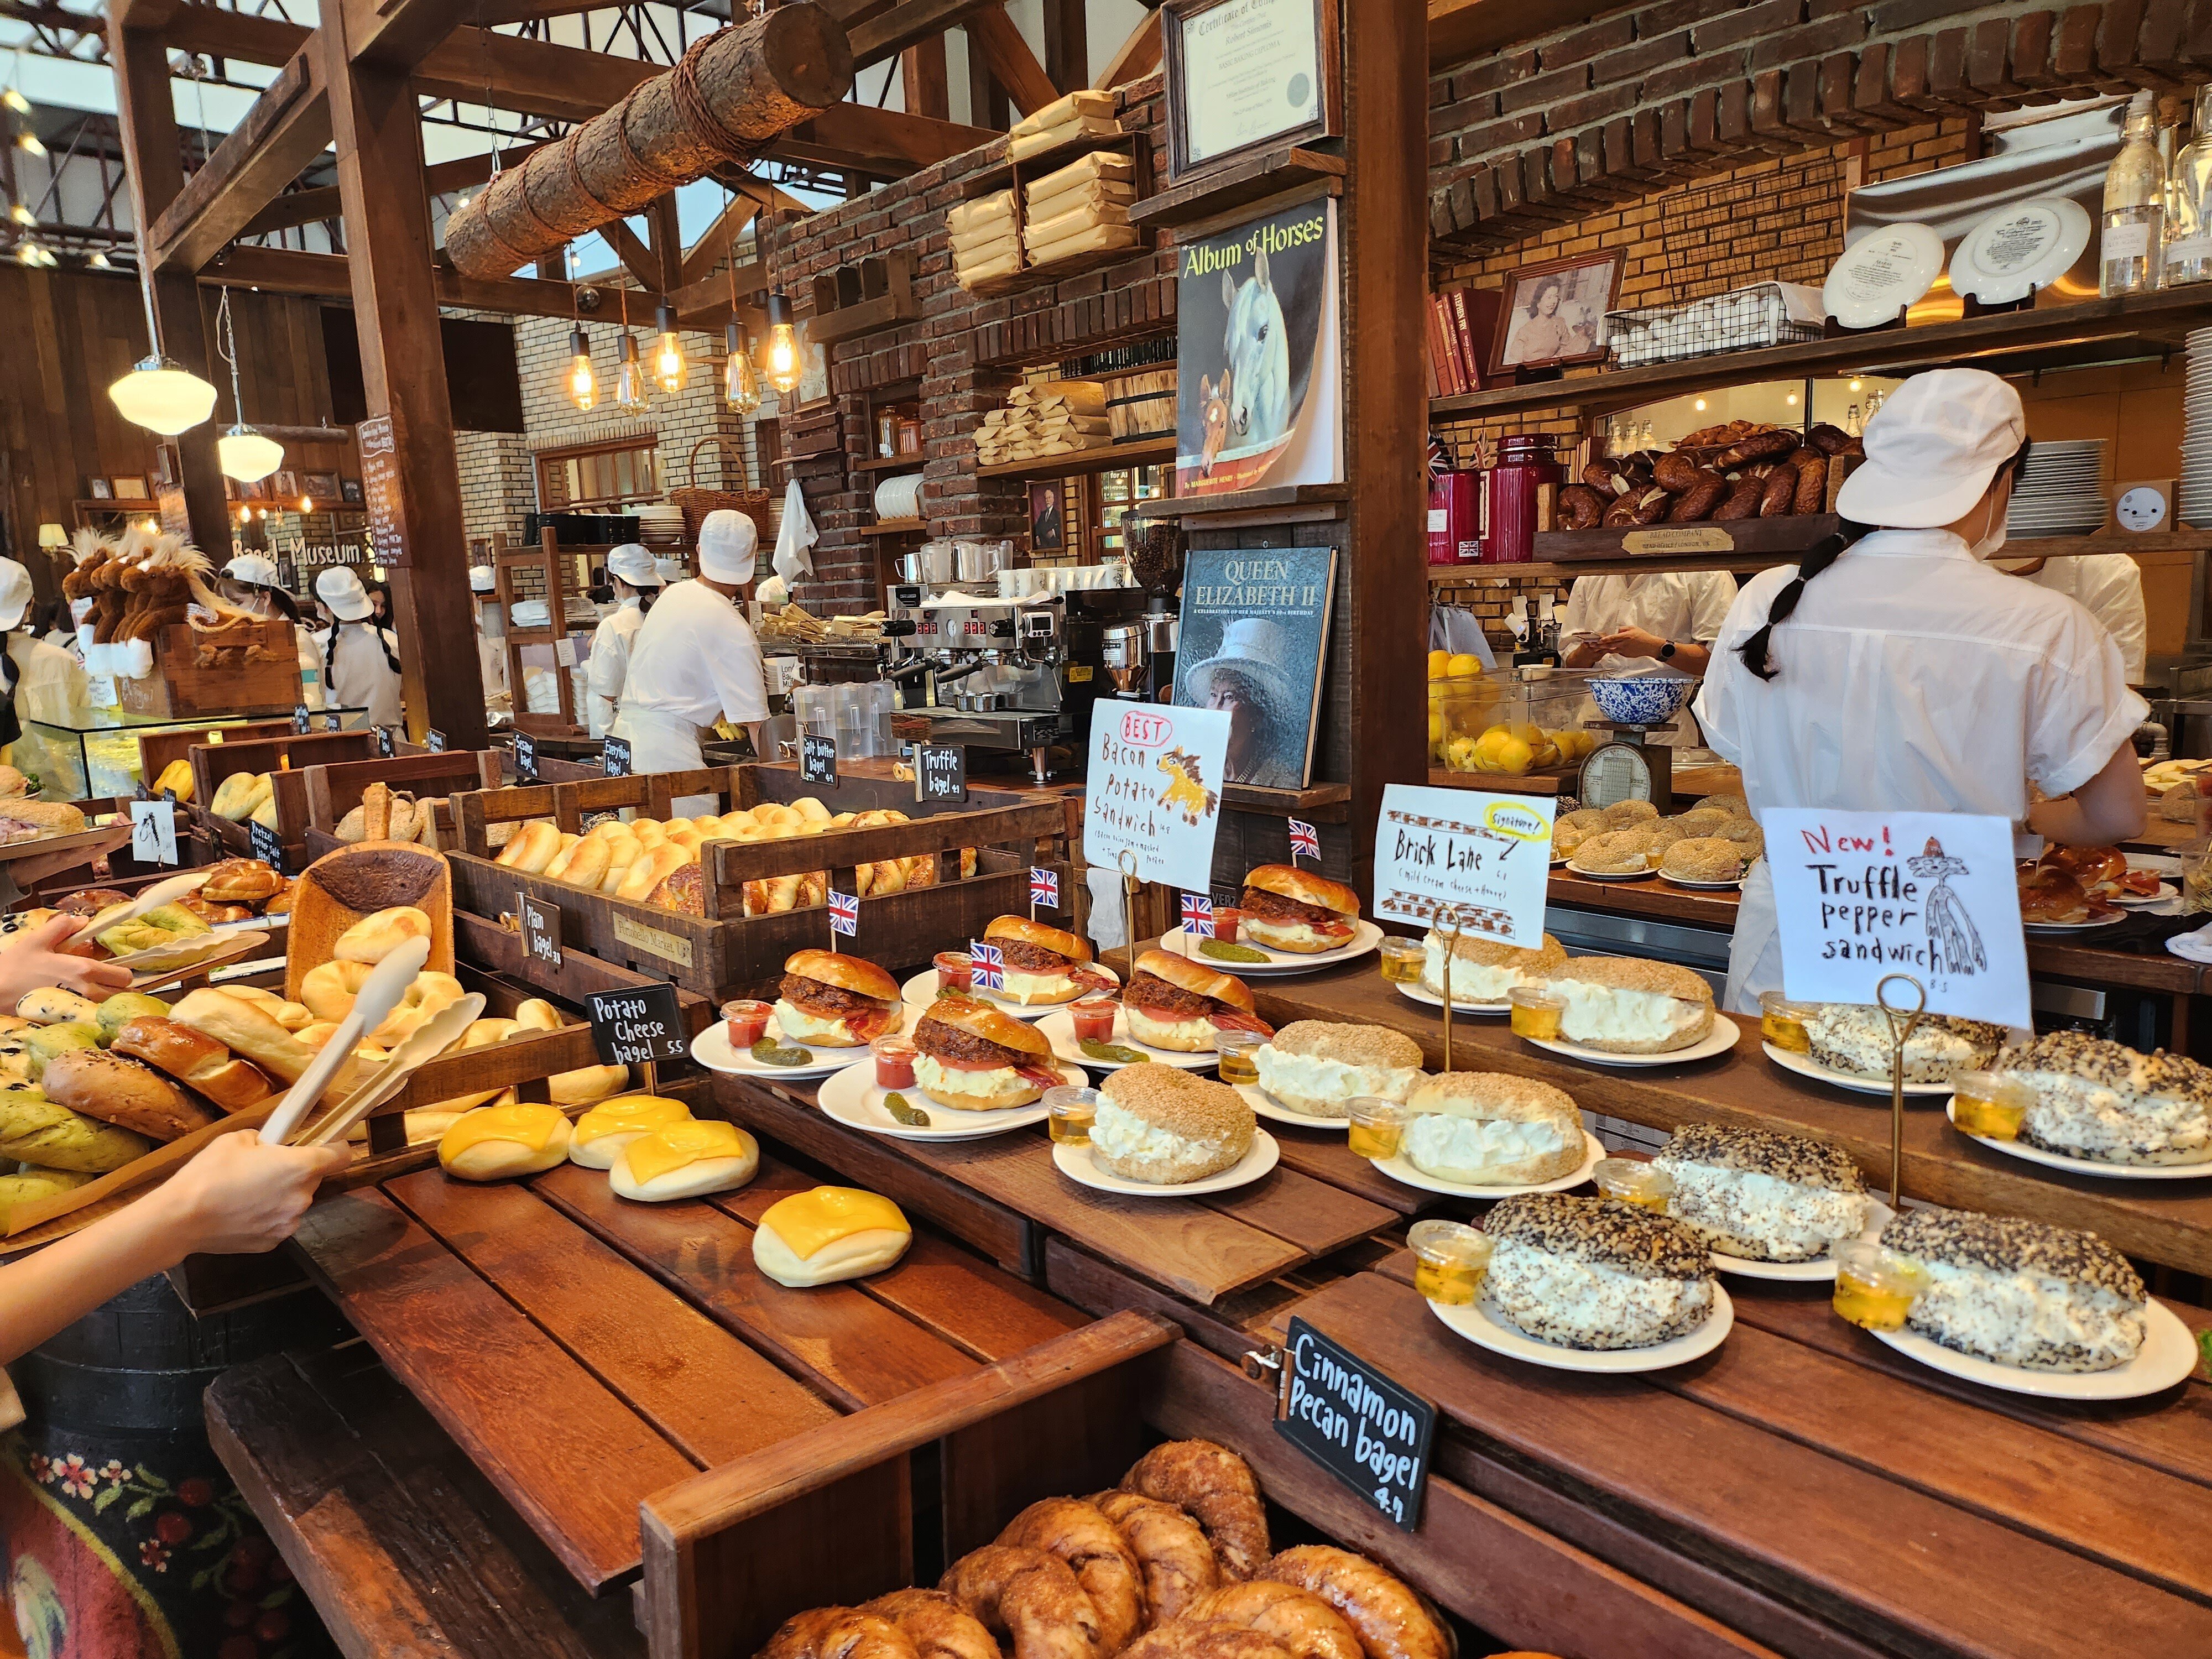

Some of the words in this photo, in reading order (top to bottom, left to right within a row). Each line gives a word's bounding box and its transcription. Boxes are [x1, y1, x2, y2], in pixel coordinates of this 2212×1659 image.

[1184, 243, 1241, 279] Album
[1245, 229, 1260, 255] of
[1262, 216, 1324, 254] Horses
[1454, 293, 1465, 320] STEPHEN
[1225, 561, 1290, 586] QUEEN
[1194, 586, 1296, 606] ELIZABETH
[1301, 586, 1316, 606] II
[1125, 716, 1164, 742] BEST
[606, 740, 630, 764] Everything
[817, 740, 835, 758] butter
[922, 749, 957, 770] Truffle
[1102, 732, 1145, 769] Bacon
[608, 757, 620, 776] bagel
[810, 756, 825, 774] bagel
[929, 770, 950, 796] bagel
[1106, 773, 1155, 802] Potato
[251, 831, 268, 850] butter
[252, 821, 273, 842] Pretzel
[1801, 824, 1895, 857] New!
[256, 846, 270, 864] bagel
[1394, 828, 1436, 869] Brick
[1447, 838, 1483, 873] Lane
[1804, 864, 1918, 902] Truffle
[527, 904, 544, 930] Plain
[1822, 901, 1918, 935] pepper
[618, 920, 649, 943] Portobello
[533, 930, 552, 960] bagel
[1821, 937, 1943, 974] sandwich
[593, 997, 646, 1022] Potato
[615, 1020, 665, 1042] Cheese
[611, 1039, 654, 1065] bagel
[1295, 1333, 1417, 1446] Cinnamon
[1355, 1417, 1420, 1490] bagel
